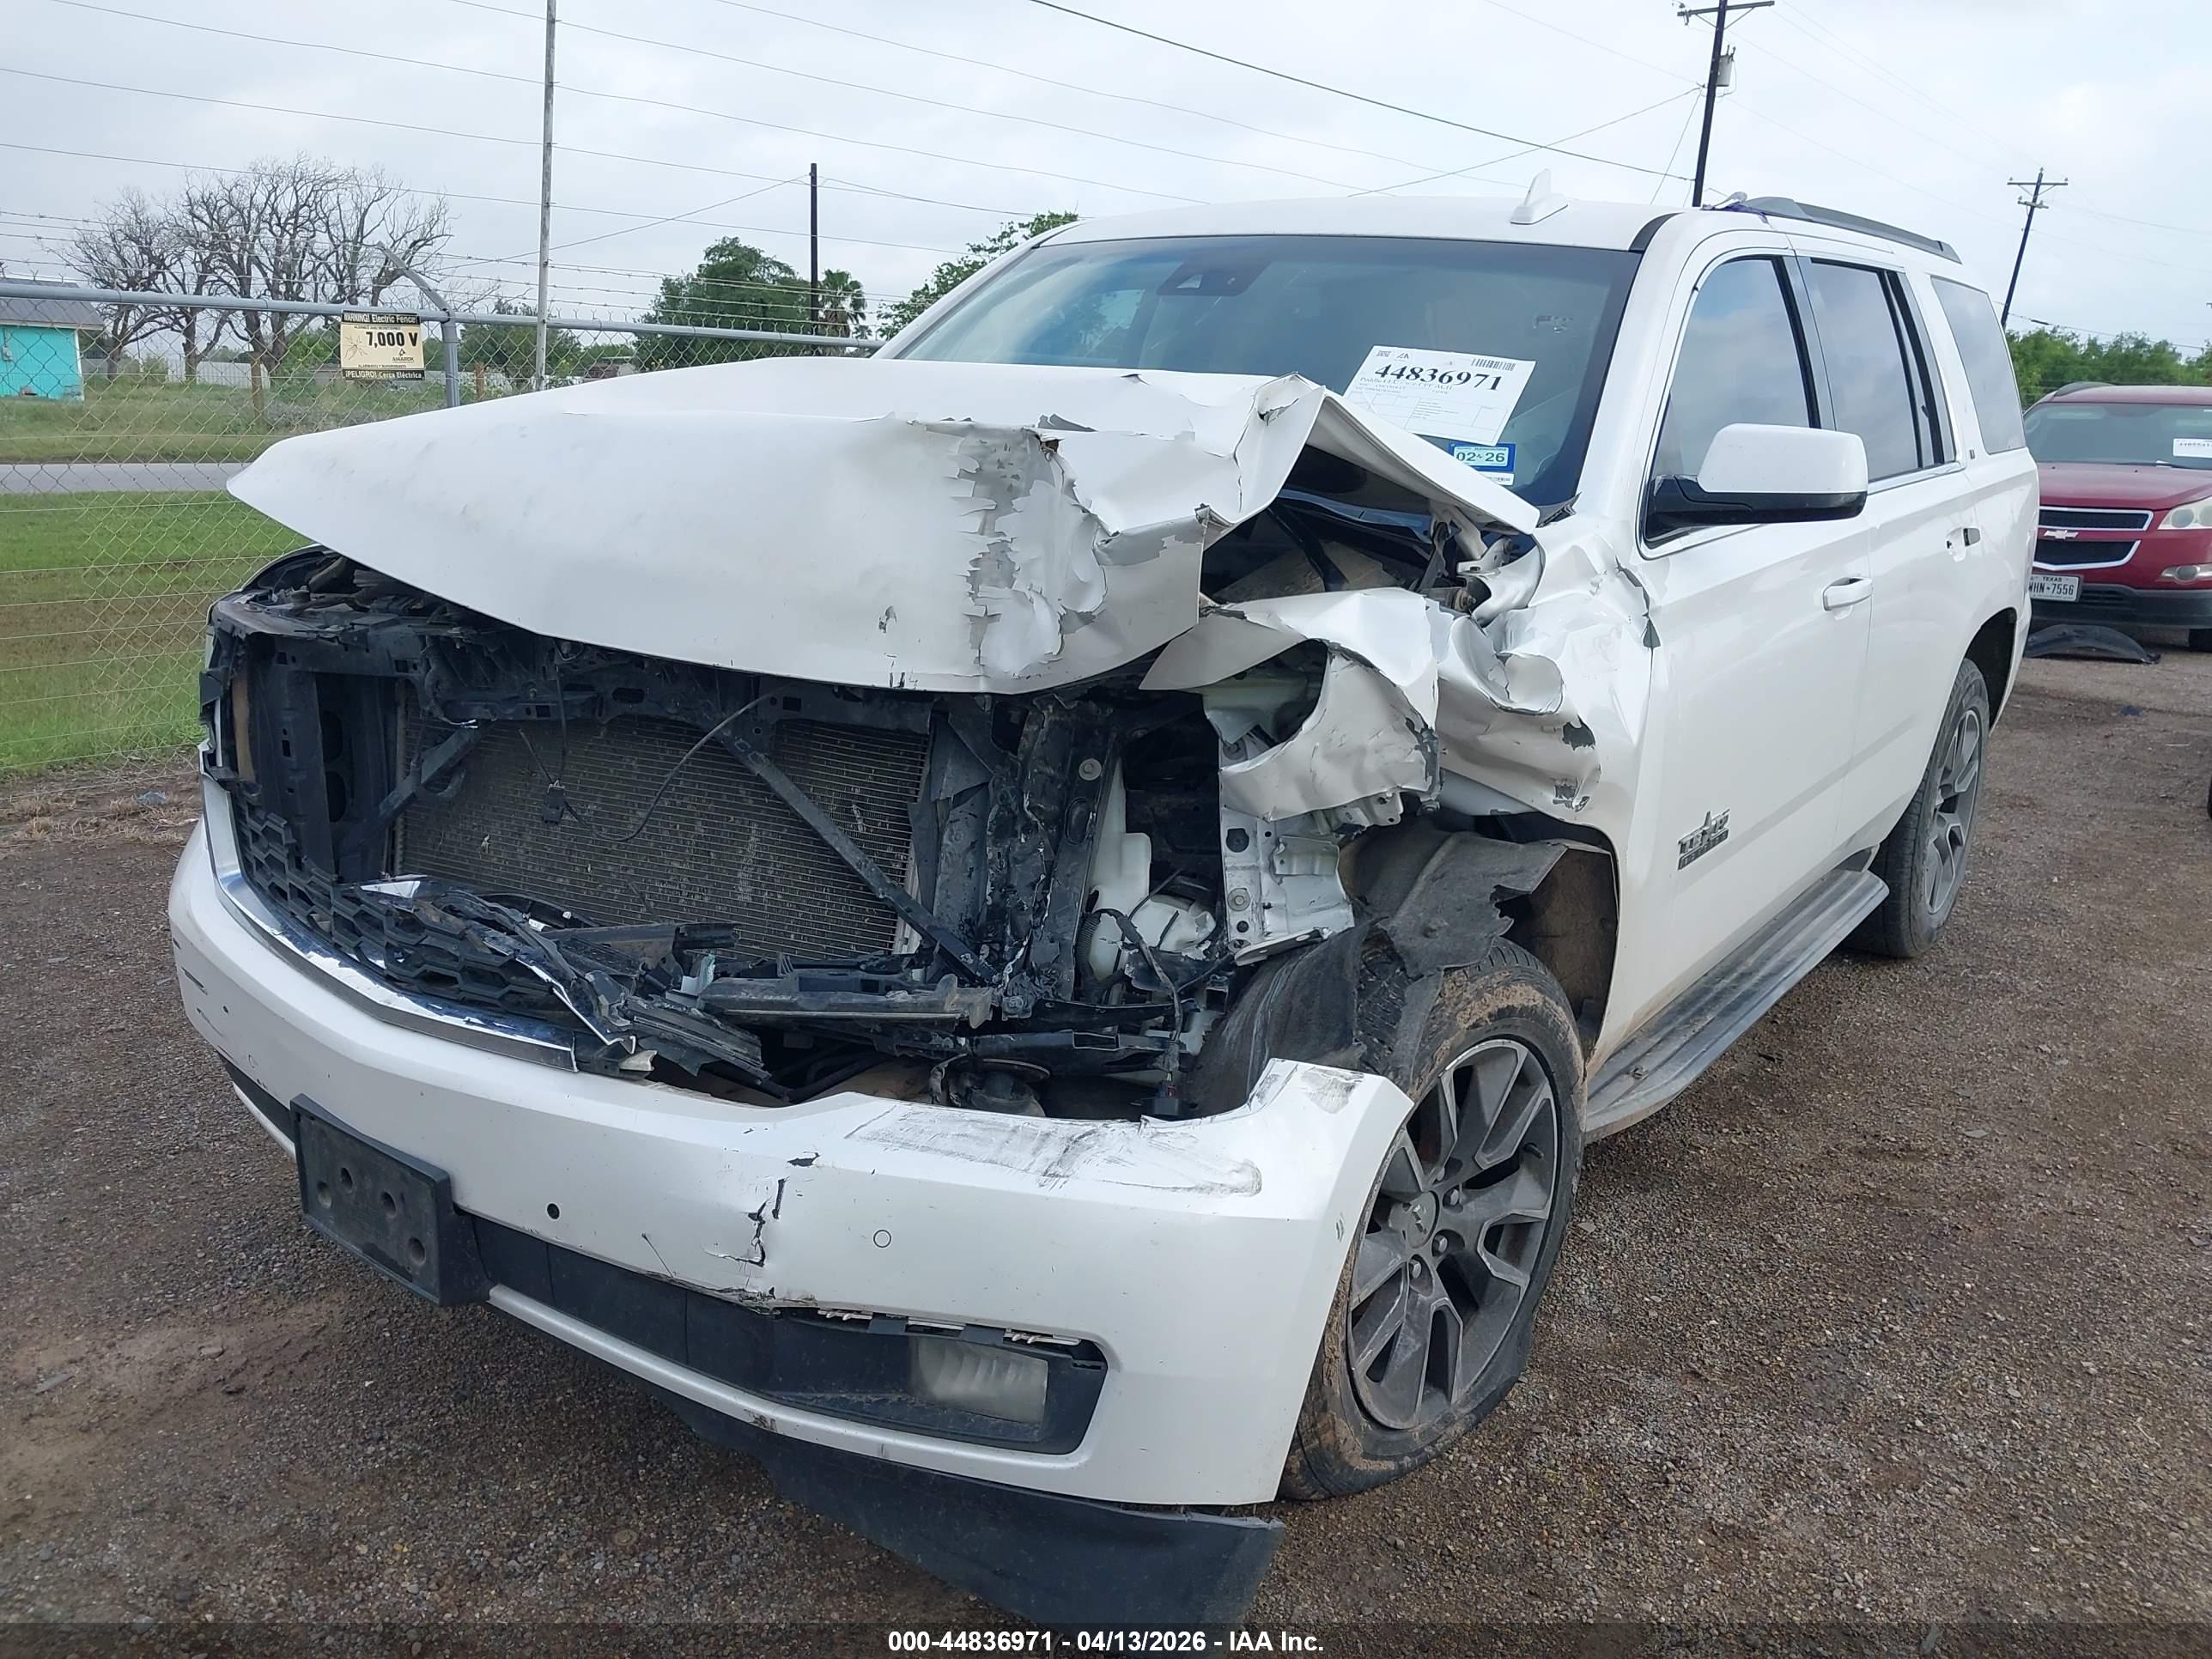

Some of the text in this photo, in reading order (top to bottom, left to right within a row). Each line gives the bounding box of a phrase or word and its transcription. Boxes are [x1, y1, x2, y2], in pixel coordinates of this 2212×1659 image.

[372, 314, 395, 323] Electric
[366, 331, 418, 348] 7,000 V
[379, 370, 395, 379] Cerca
[1375, 364, 1503, 391] 44836971
[1455, 452, 1505, 463] 02 26
